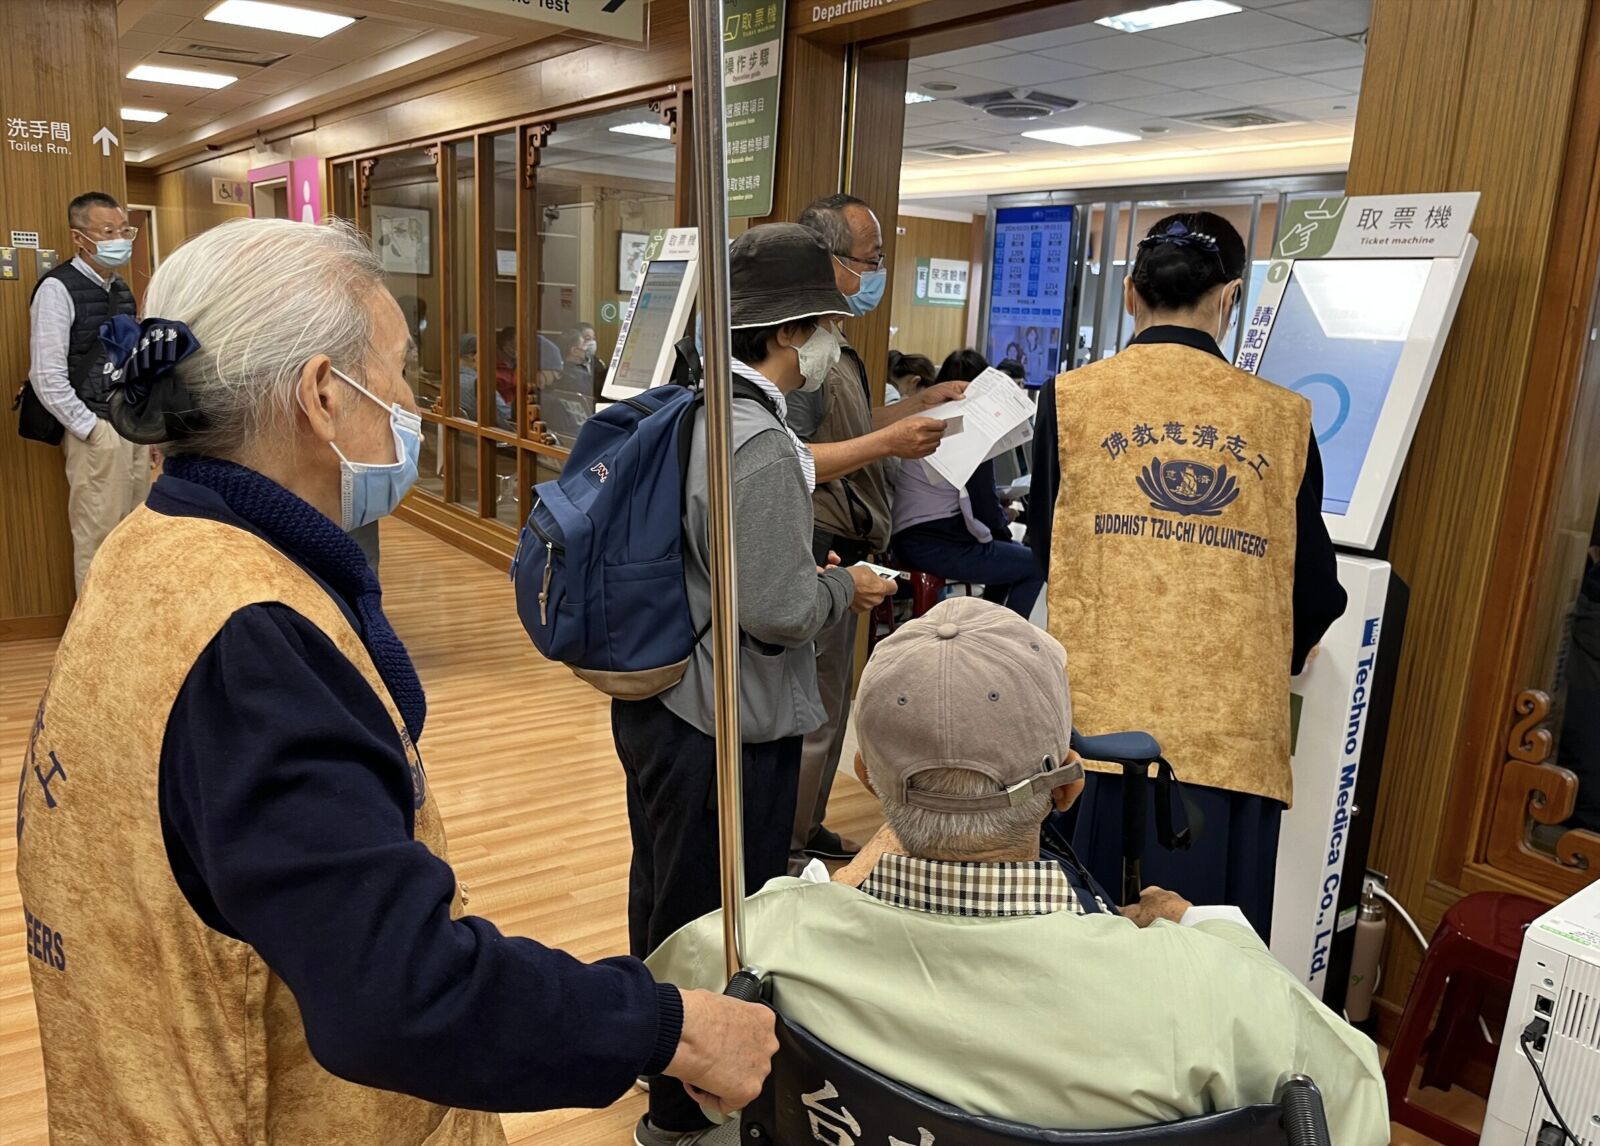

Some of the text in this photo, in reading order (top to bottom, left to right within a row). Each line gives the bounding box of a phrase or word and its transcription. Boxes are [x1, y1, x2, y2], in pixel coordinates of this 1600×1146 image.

[7, 117, 71, 142] 洗手間
[8, 139, 72, 155] Toilet Rm.
[1356, 205, 1452, 230] 取票機
[1360, 234, 1435, 245] Ticket machine
[1274, 265, 1282, 280] 1
[1237, 306, 1275, 373] 請點選
[1101, 421, 1270, 480] 佛教慈濟志工
[1094, 514, 1268, 558] BUDDHIST TZU-CHI VOLUNTEERS
[1309, 652, 1374, 982] Techno Medica Co., Ltd.
